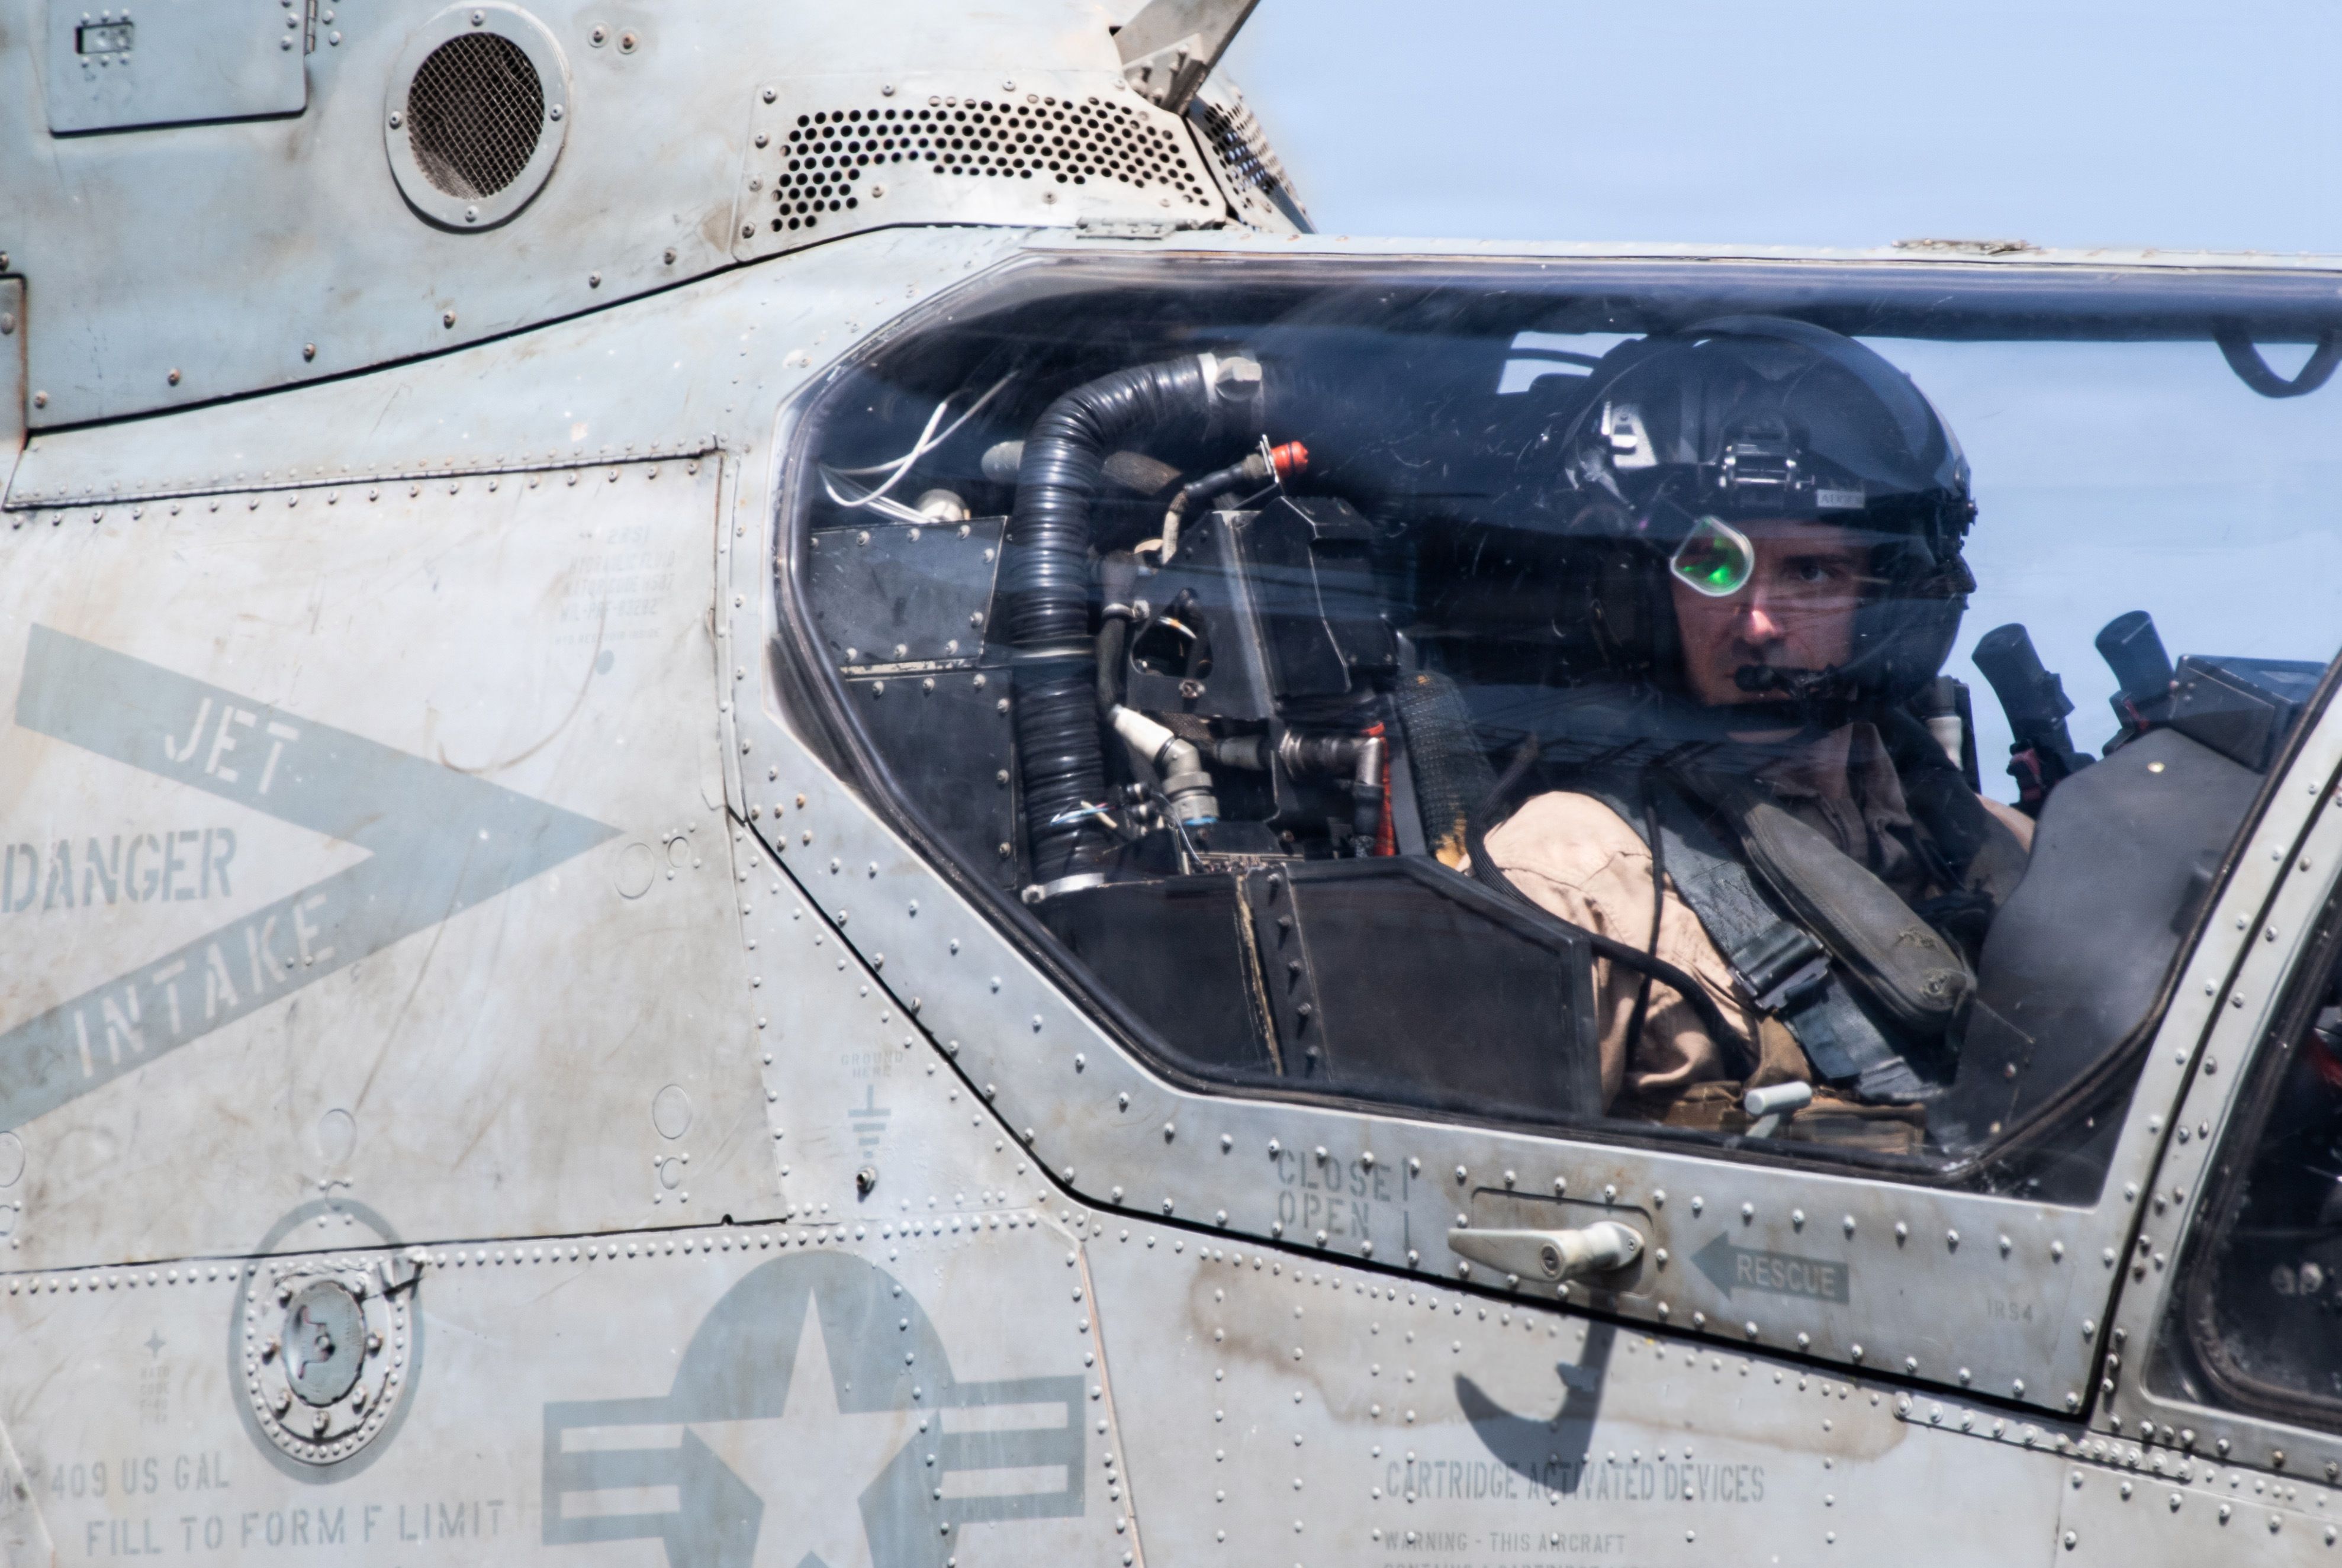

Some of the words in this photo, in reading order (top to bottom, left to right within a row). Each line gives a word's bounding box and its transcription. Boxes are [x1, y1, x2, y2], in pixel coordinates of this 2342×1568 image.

[166, 698, 300, 794] JET
[2, 828, 237, 912] DANGER
[74, 893, 334, 1077] INTAKE
[841, 1051, 903, 1065] GROUND
[1278, 1149, 1391, 1202] CLOSE
[1279, 1190, 1369, 1238] OPEN
[1736, 1253, 1835, 1296] RESCUE
[51, 1461, 107, 1499] 409
[121, 1457, 159, 1495] US
[174, 1451, 230, 1492] GAL
[1386, 1461, 1517, 1500] CARTRIDGE
[1527, 1462, 1655, 1501] ACTIVATED
[1664, 1463, 1765, 1502] DEVICES
[86, 1518, 162, 1557] FILL
[179, 1515, 223, 1552] TO
[242, 1507, 346, 1548] FORM
[363, 1505, 382, 1543] F
[399, 1501, 504, 1541] LIMIT
[1384, 1532, 1467, 1551] WARNING
[1490, 1532, 1530, 1553] THIS
[1539, 1532, 1626, 1554] AIRCRAFT
